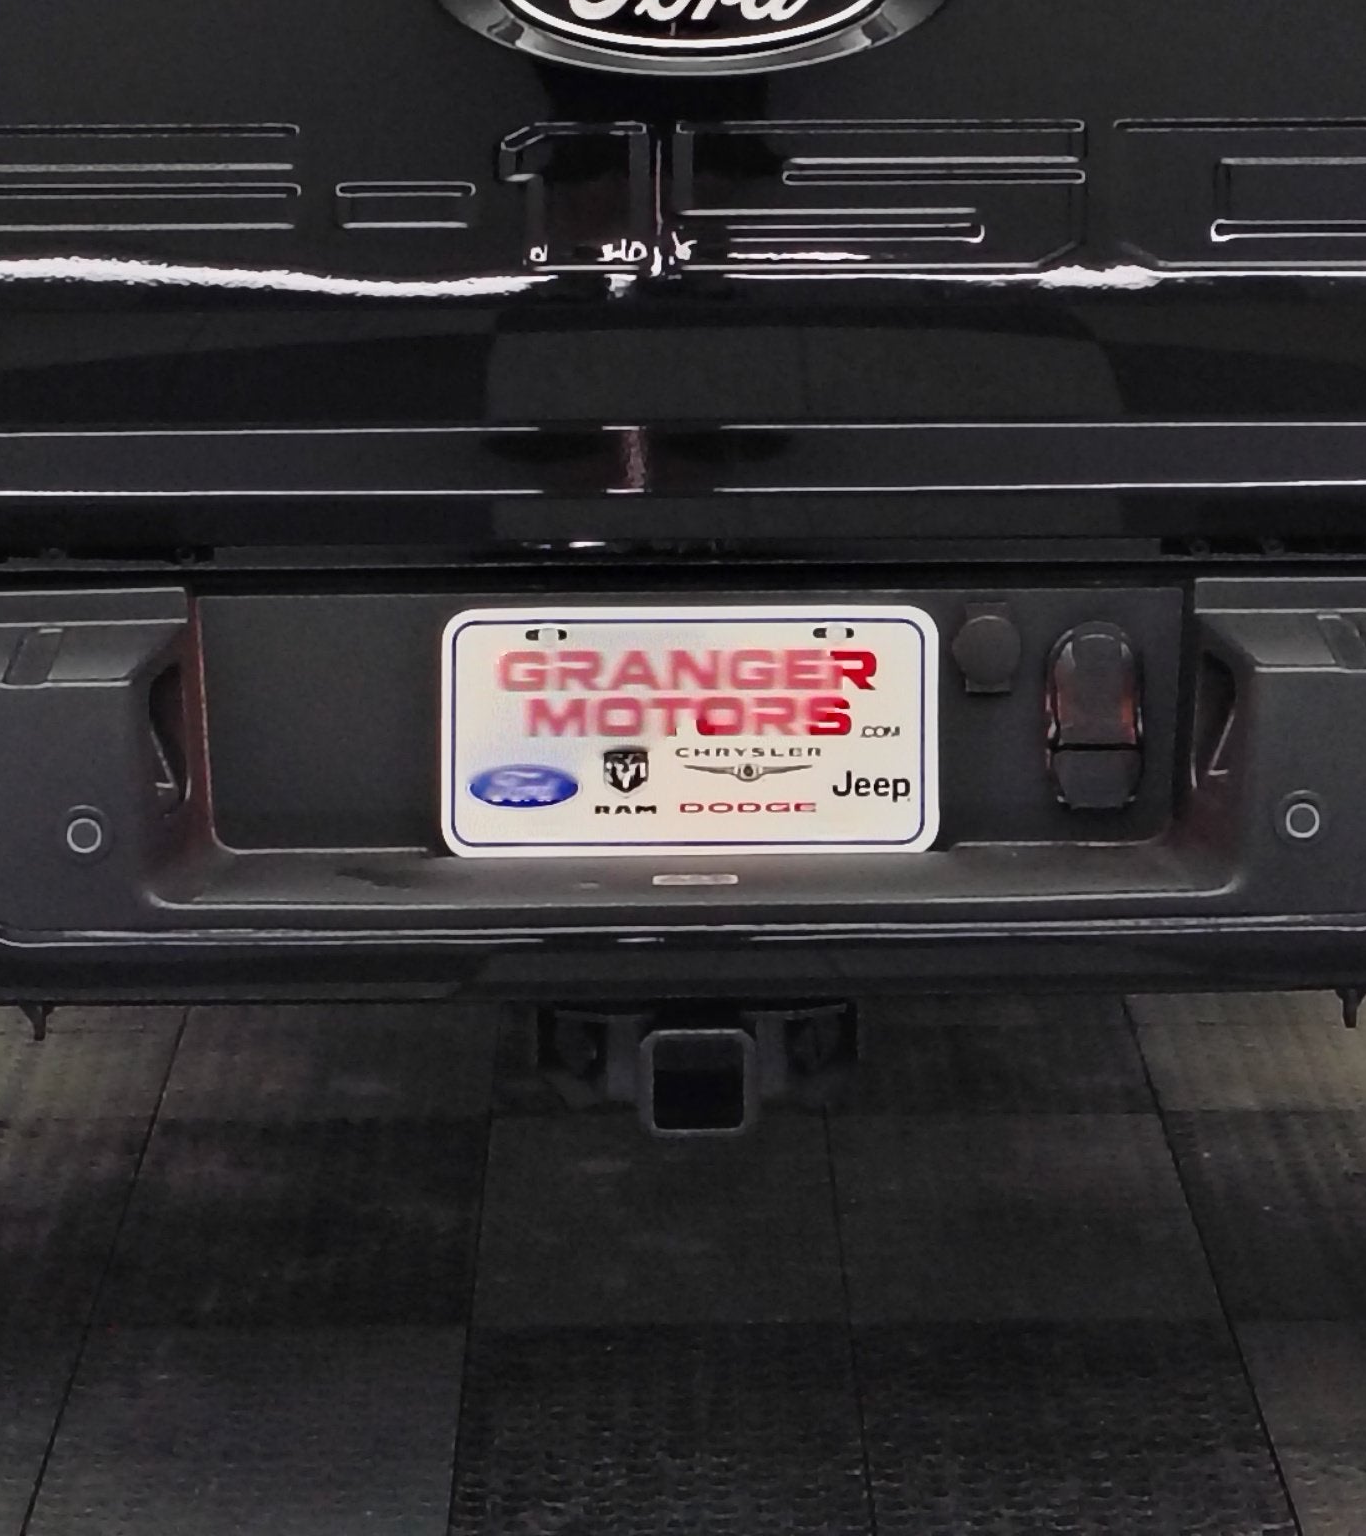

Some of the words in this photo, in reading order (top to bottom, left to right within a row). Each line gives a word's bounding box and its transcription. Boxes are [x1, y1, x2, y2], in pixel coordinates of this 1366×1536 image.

[499, 649, 878, 691] GRANGER
[527, 695, 853, 738] MOTORS
[674, 746, 823, 758] CHRYSLER
[832, 770, 911, 803] Jeep
[594, 804, 657, 815] RAM
[679, 802, 818, 814] DODGE
